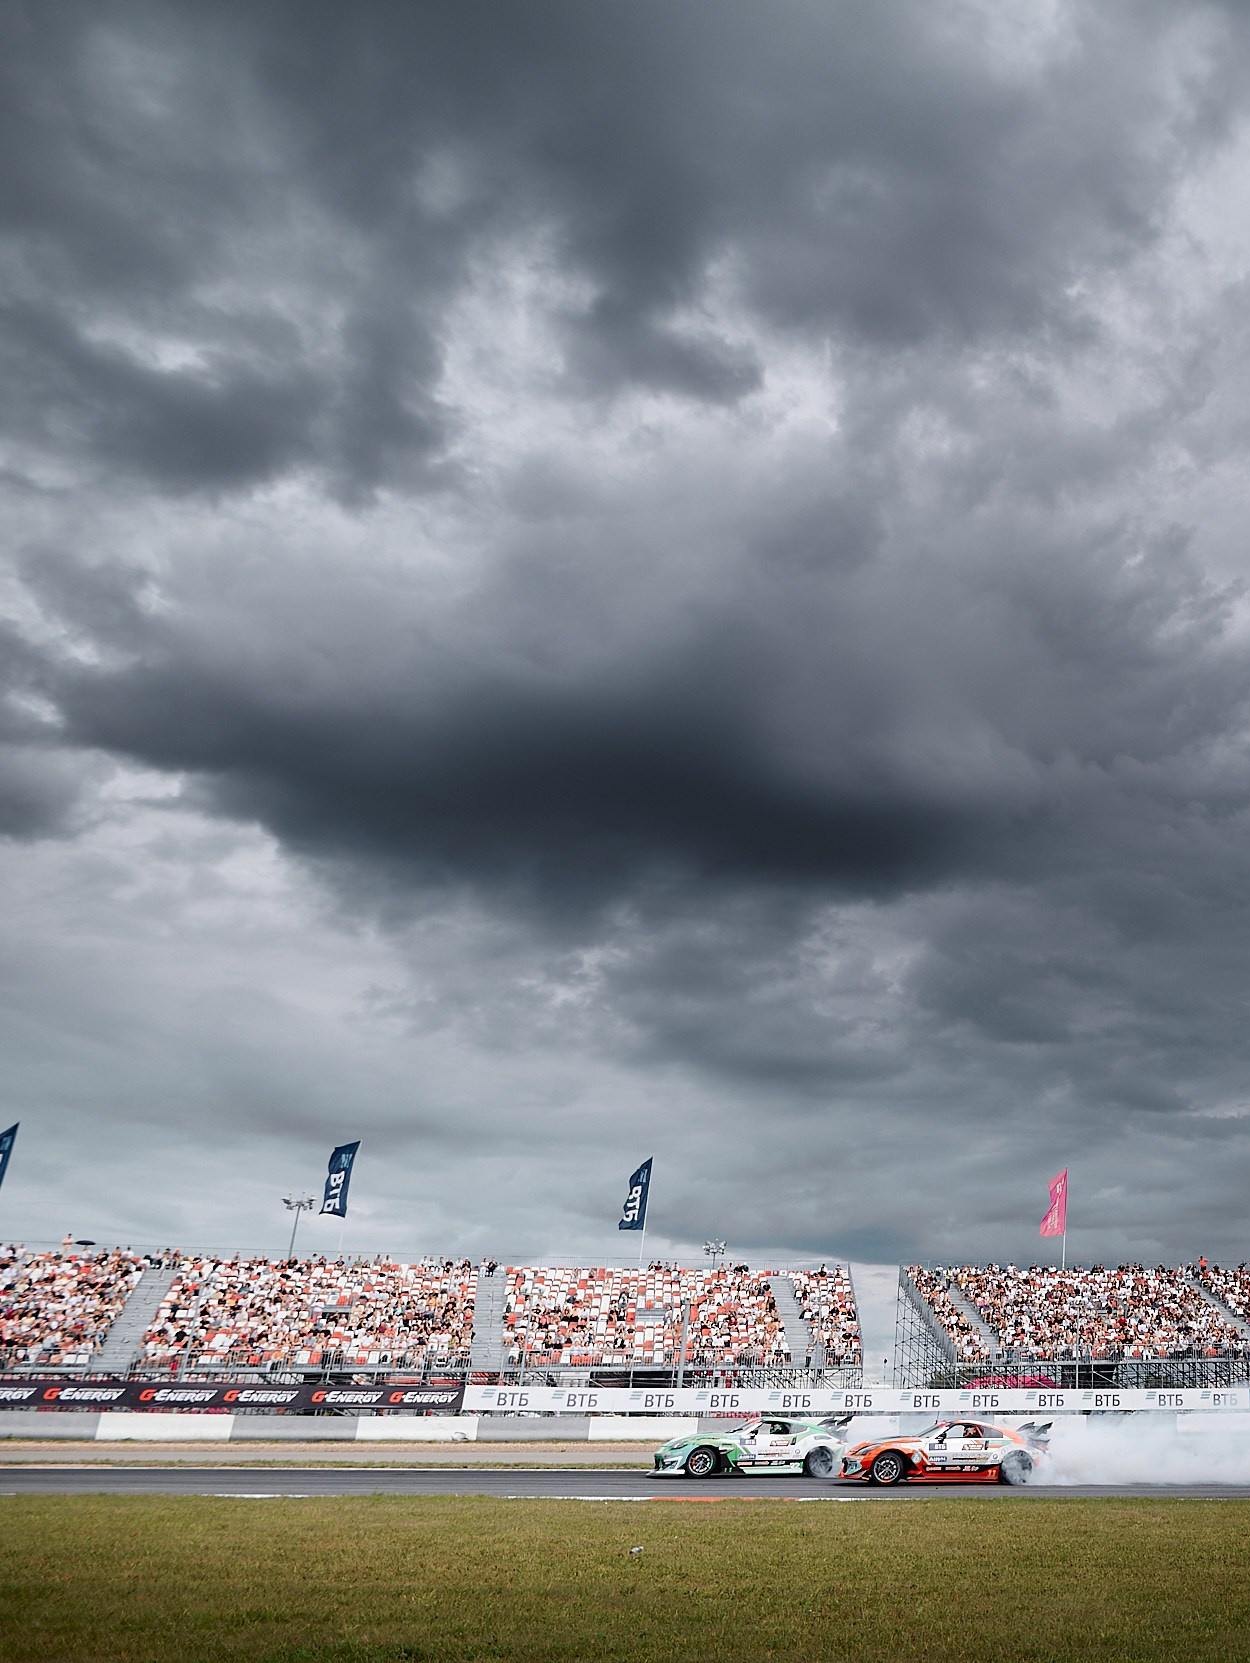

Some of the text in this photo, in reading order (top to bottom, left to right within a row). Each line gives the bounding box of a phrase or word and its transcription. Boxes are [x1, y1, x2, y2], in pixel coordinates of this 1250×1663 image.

[323, 1171, 345, 1212] ВТБ
[623, 1185, 642, 1222] ВТБ
[497, 1392, 529, 1407] ВТБ
[566, 1393, 598, 1407] ВТБ
[644, 1394, 674, 1408] ВТБ
[710, 1394, 739, 1408] ВТБ
[782, 1394, 811, 1408] ВТБ
[844, 1394, 872, 1408] ВТБ
[913, 1395, 941, 1408] ВТБ
[972, 1394, 999, 1408] ВТБ
[1038, 1394, 1064, 1407] ВТБ
[1095, 1394, 1120, 1407] ВТБ
[1158, 1393, 1183, 1407] ВТБ
[1213, 1393, 1238, 1406] ВТБ
